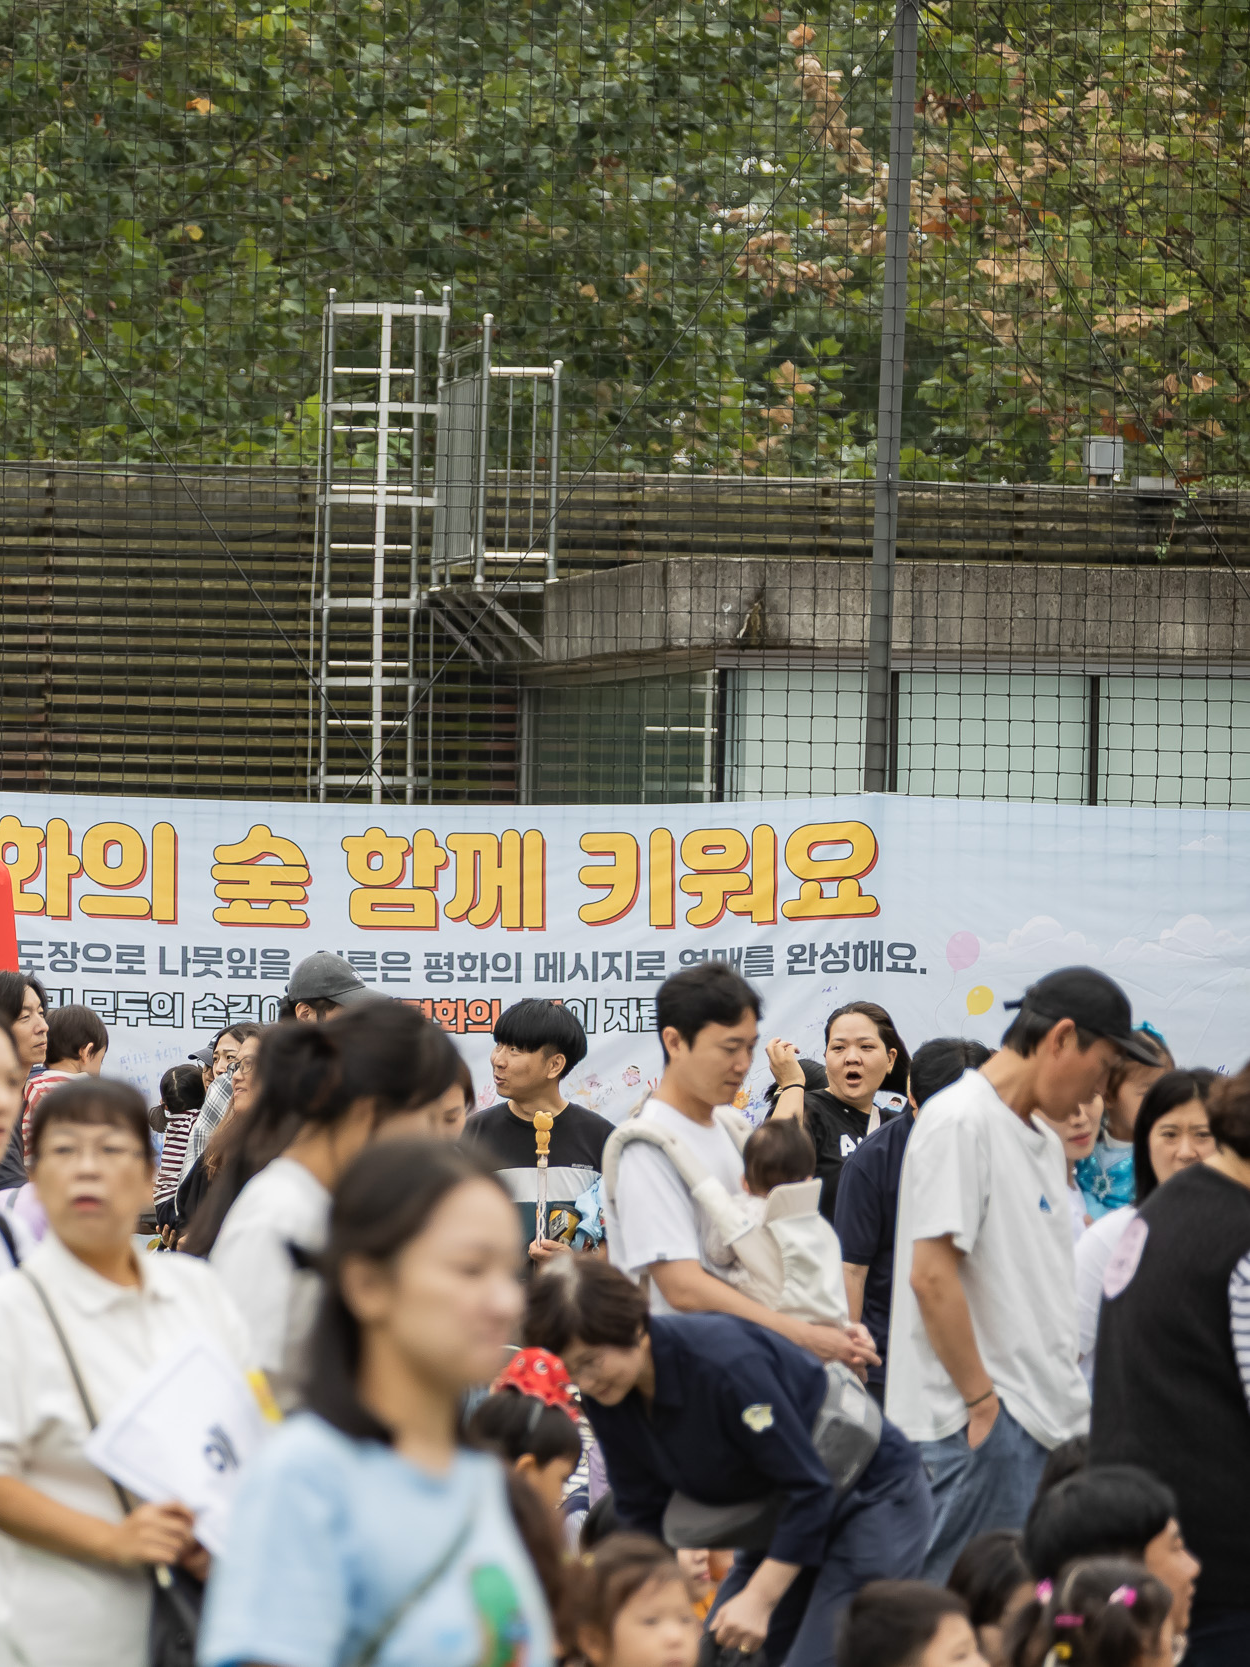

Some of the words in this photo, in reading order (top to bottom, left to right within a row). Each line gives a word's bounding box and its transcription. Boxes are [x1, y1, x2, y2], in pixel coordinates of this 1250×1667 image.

[210, 824, 312, 929] 숲
[341, 826, 547, 932] 함께
[578, 820, 882, 931] 키워요
[158, 946, 292, 981] 나뭇잎을
[337, 950, 412, 983] 른은
[423, 951, 522, 984] 평화의
[534, 950, 667, 983] 메시지로
[786, 940, 928, 976] 완성해요.
[82, 989, 185, 1029] 모두의
